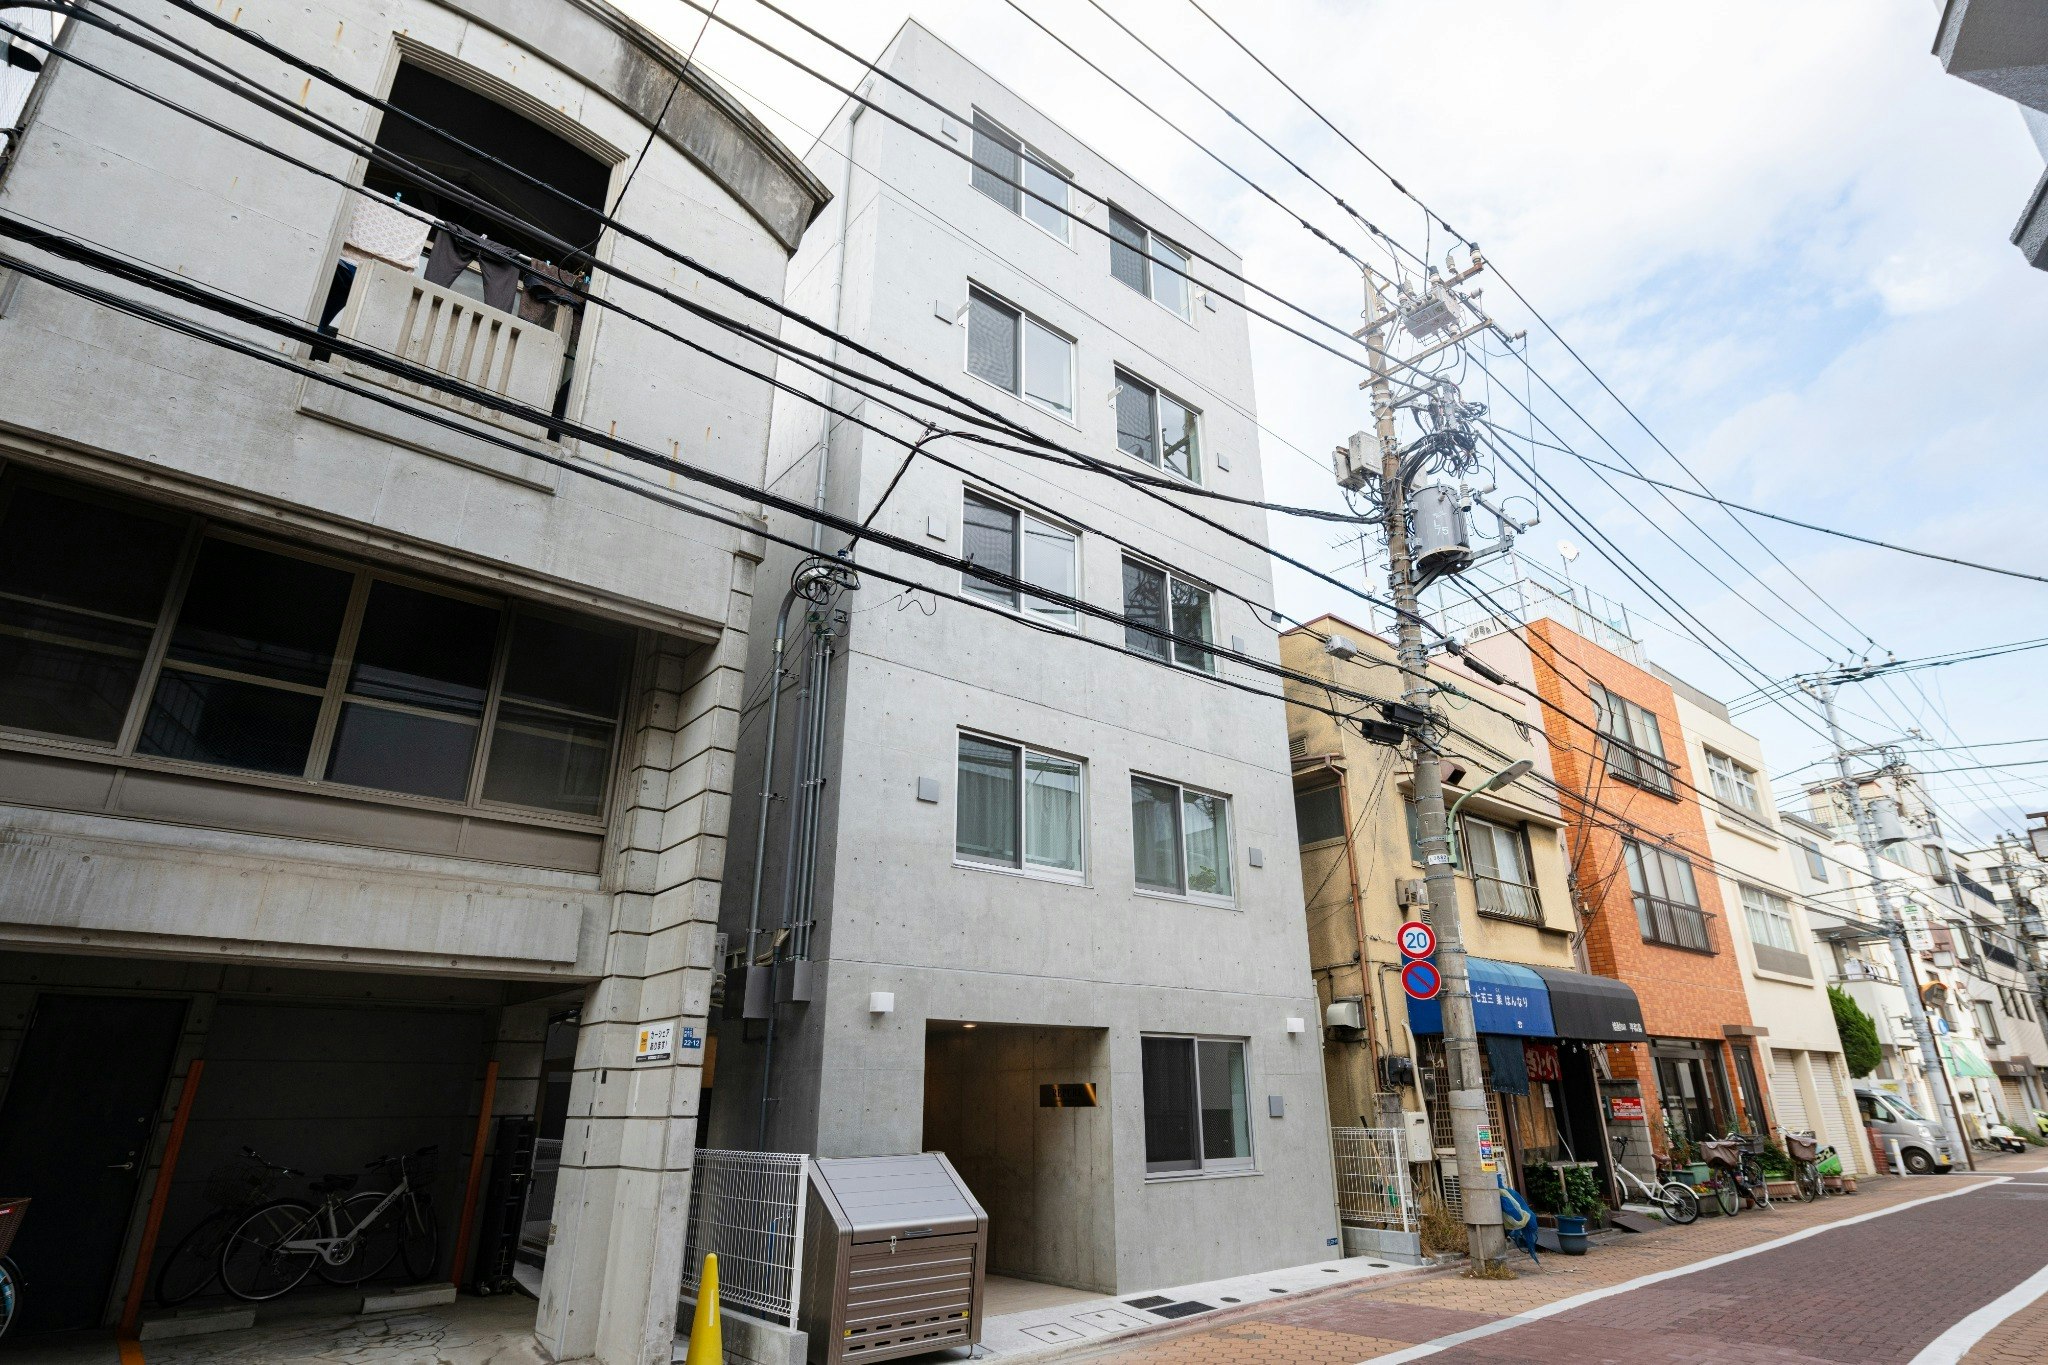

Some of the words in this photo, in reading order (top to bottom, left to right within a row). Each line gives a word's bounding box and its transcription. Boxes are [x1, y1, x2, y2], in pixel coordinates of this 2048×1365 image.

[1434, 526, 1449, 536] 75
[1405, 932, 1427, 949] 20
[683, 1039, 700, 1048] 22-12
